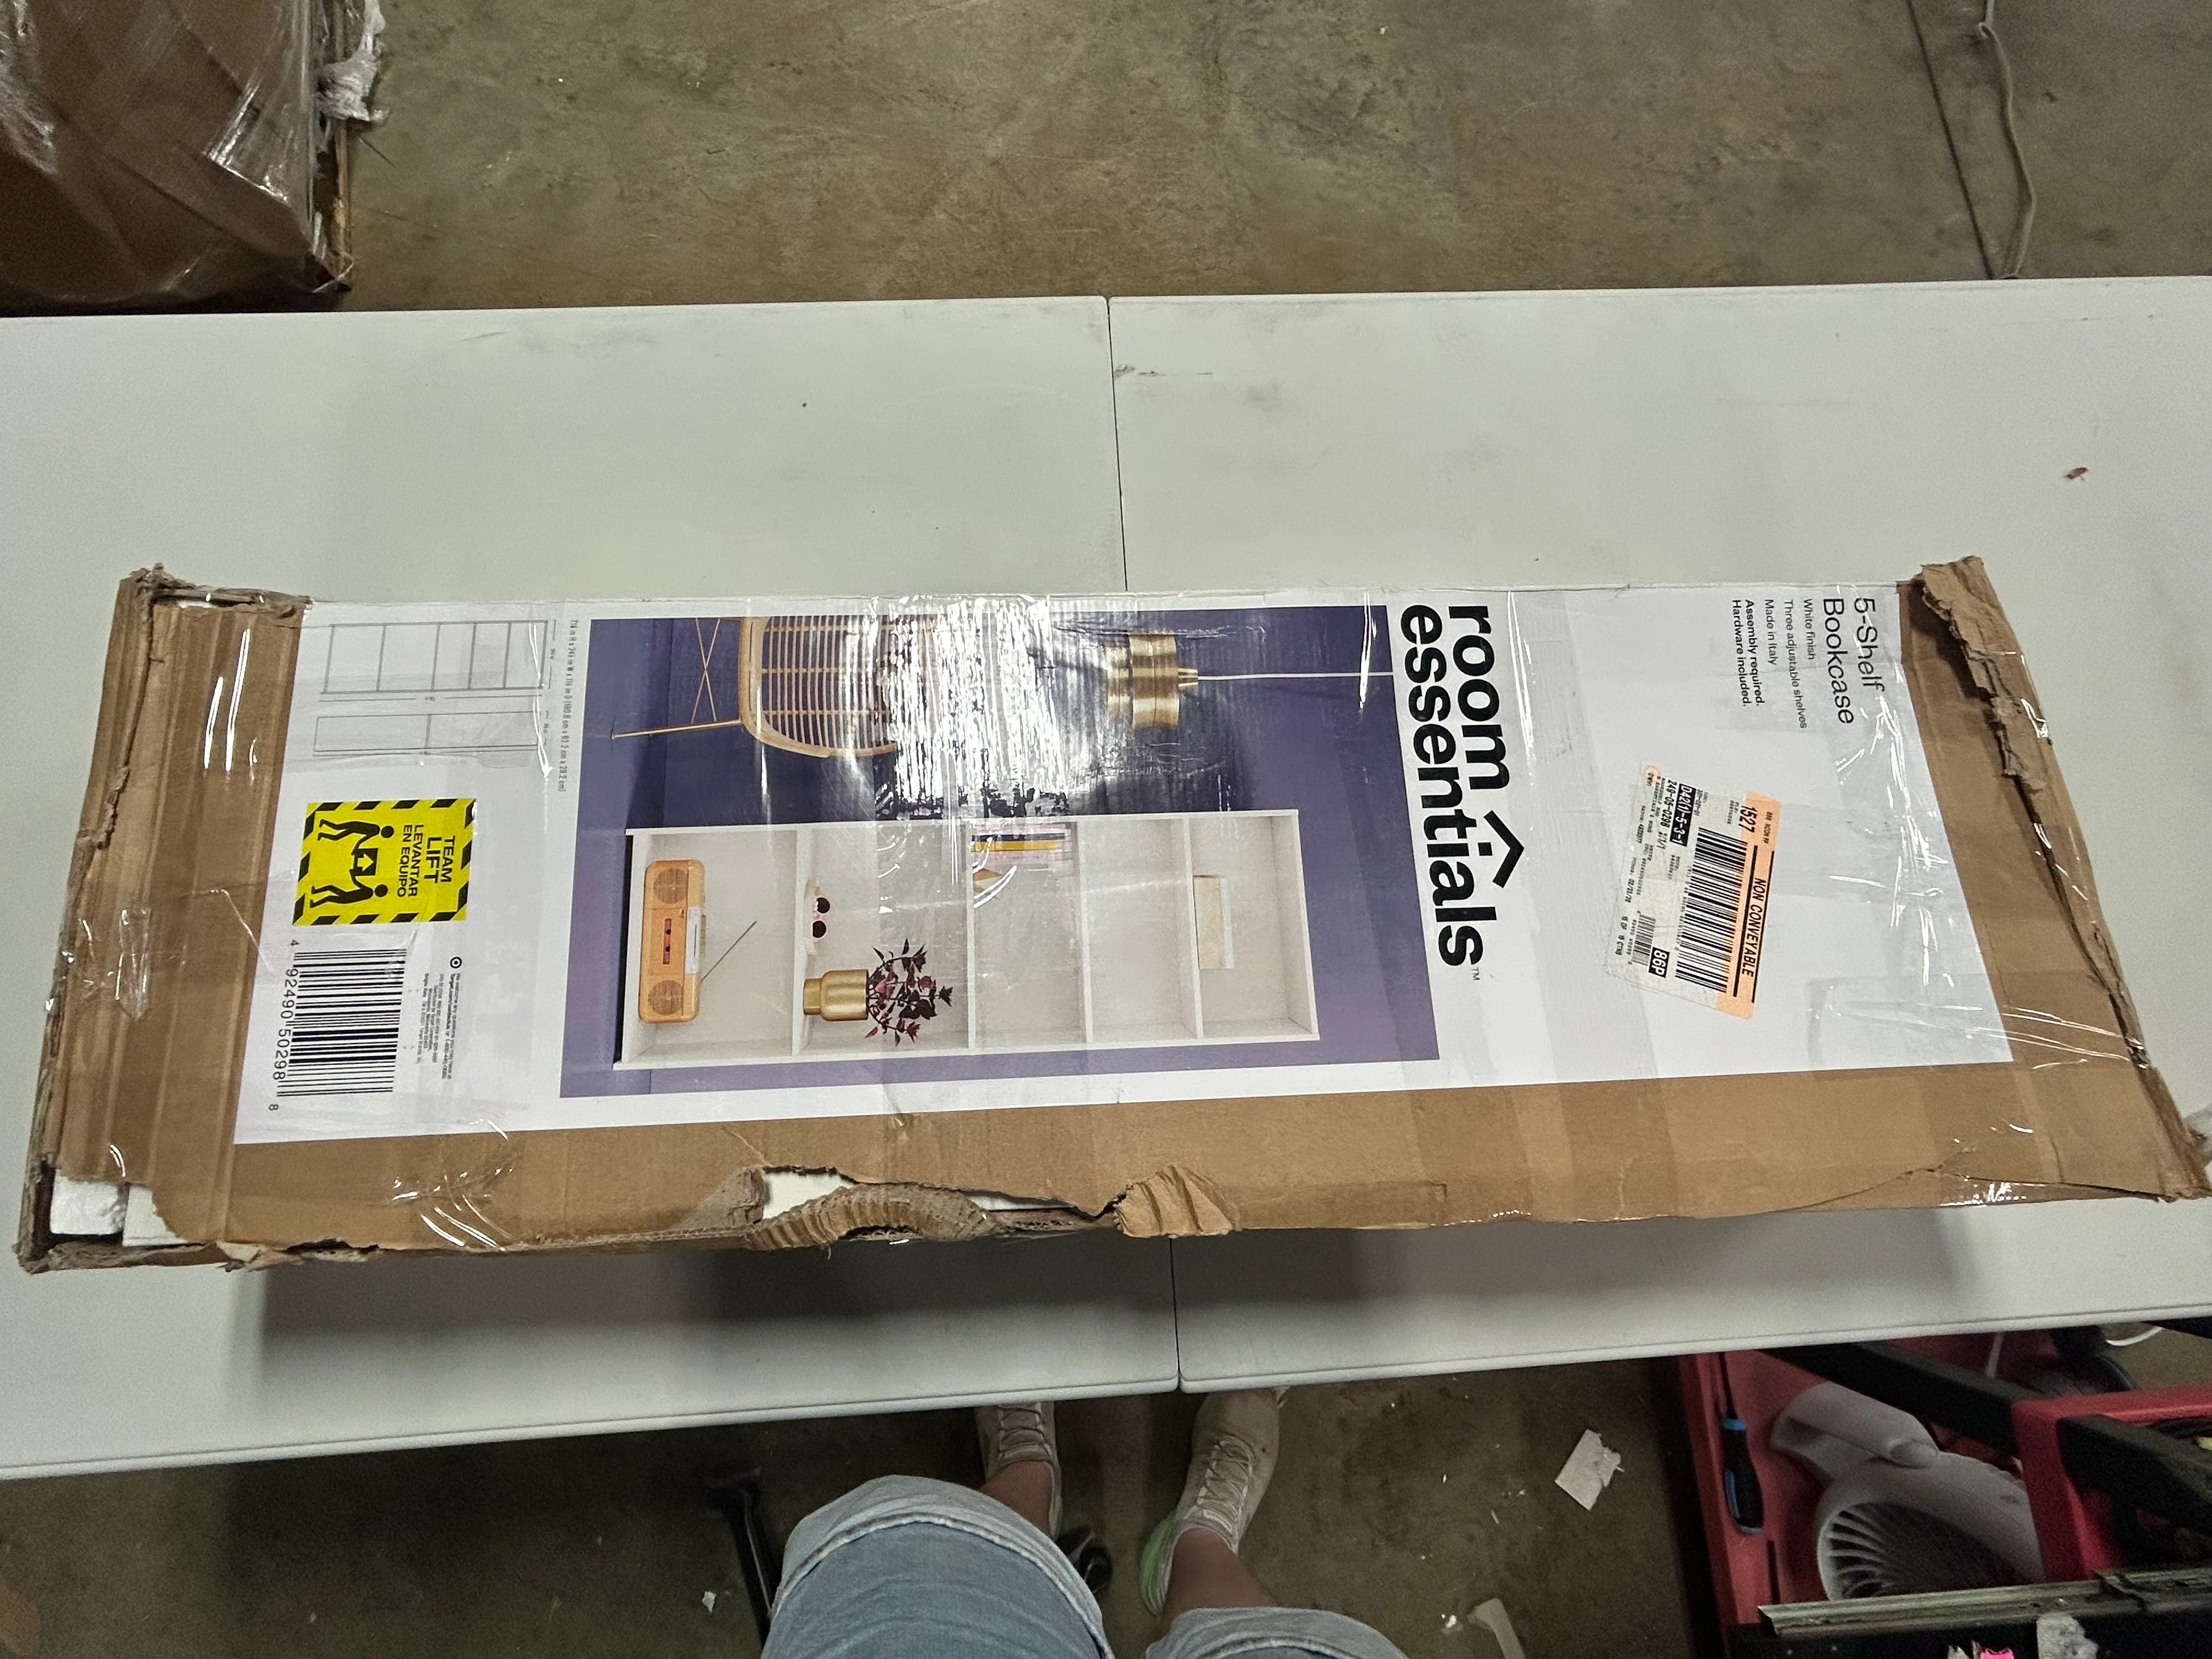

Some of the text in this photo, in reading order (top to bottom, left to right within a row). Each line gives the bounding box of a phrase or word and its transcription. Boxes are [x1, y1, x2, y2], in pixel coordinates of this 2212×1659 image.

[1732, 600, 1752, 707] Hardware included.
[1745, 600, 1765, 706] Assembly required.
[1764, 600, 1779, 665] Made in Italy
[1784, 599, 1807, 729] Three adjustable shelves
[1803, 599, 1816, 660] White finish
[1823, 599, 1854, 724] Bookcase
[1854, 597, 1885, 692] 5-Shelf
[1448, 606, 1510, 789] room
[1401, 605, 1497, 966] essentials
[1660, 780, 1677, 828] 249-05-0298
[1738, 805, 1758, 833] 1527
[397, 825, 413, 898] EN EQUIPO
[408, 825, 424, 897] LEVANTAR
[424, 837, 442, 884] LIFT
[441, 835, 455, 882] TEAM
[1651, 785, 1692, 975] D42(1)-5-3-1 86P
[1742, 877, 1767, 977] NON CONVEYABLE
[280, 968, 299, 1019] 92490
[273, 1029, 291, 1082] 50298
